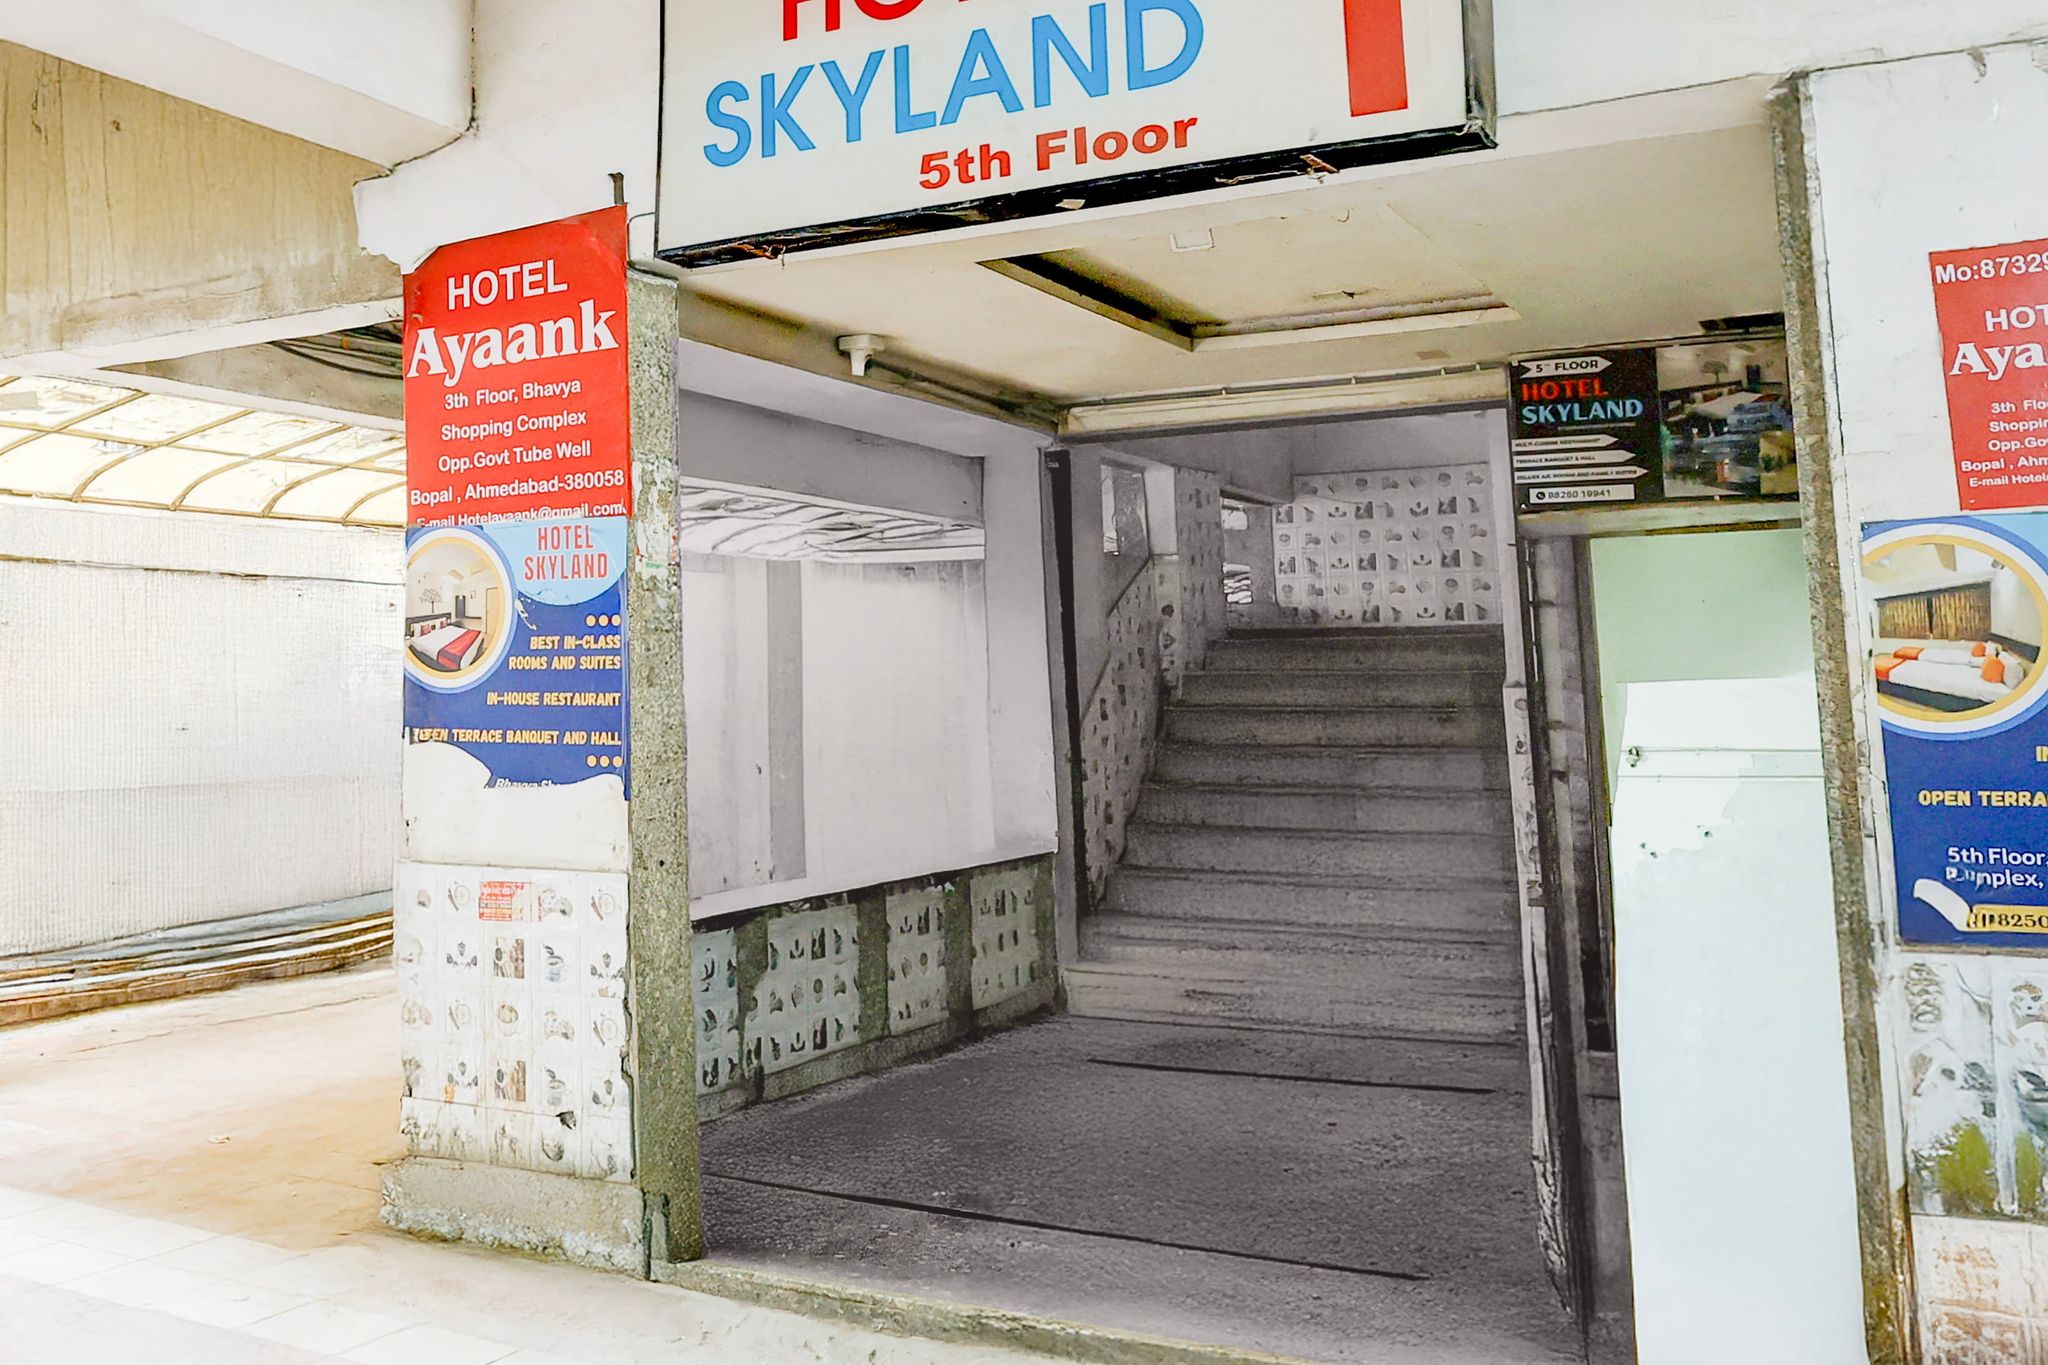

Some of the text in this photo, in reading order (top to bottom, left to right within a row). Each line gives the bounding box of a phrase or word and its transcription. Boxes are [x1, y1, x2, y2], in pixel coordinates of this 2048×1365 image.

[703, 0, 1204, 167] SKYLAND
[919, 117, 1198, 189] 5th Floor
[448, 259, 568, 310] HOTEL
[406, 299, 619, 387] Ayaank
[1555, 360, 1598, 371] FLOOR
[445, 380, 581, 409] 3th Floor, Bhavya
[1520, 378, 1608, 400] HOTEL
[1522, 399, 1643, 424] SKYLAND
[1991, 402, 2016, 413] 3th
[441, 410, 586, 441] Shopping Complex
[438, 440, 591, 473] Opp.Govt Tube Well
[1961, 458, 2005, 472] Bopal
[411, 487, 452, 508] Bopal
[464, 469, 625, 500] Ahmedabad-380058
[1969, 475, 2009, 487] E-mail
[538, 525, 594, 551] HOTEL
[524, 553, 608, 581] SKYLAND
[530, 635, 621, 650] BEST IN-CLASS
[508, 655, 621, 670] ROOMS AND SUITES
[487, 691, 621, 706] IN-HOUSE RESTAURANT
[452, 728, 503, 743] TERRACE
[506, 730, 559, 744] BANQUET
[563, 731, 588, 745] AND
[591, 731, 622, 745] HALL
[1919, 790, 1972, 806] OPEN
[1948, 847, 1984, 864] 5th
